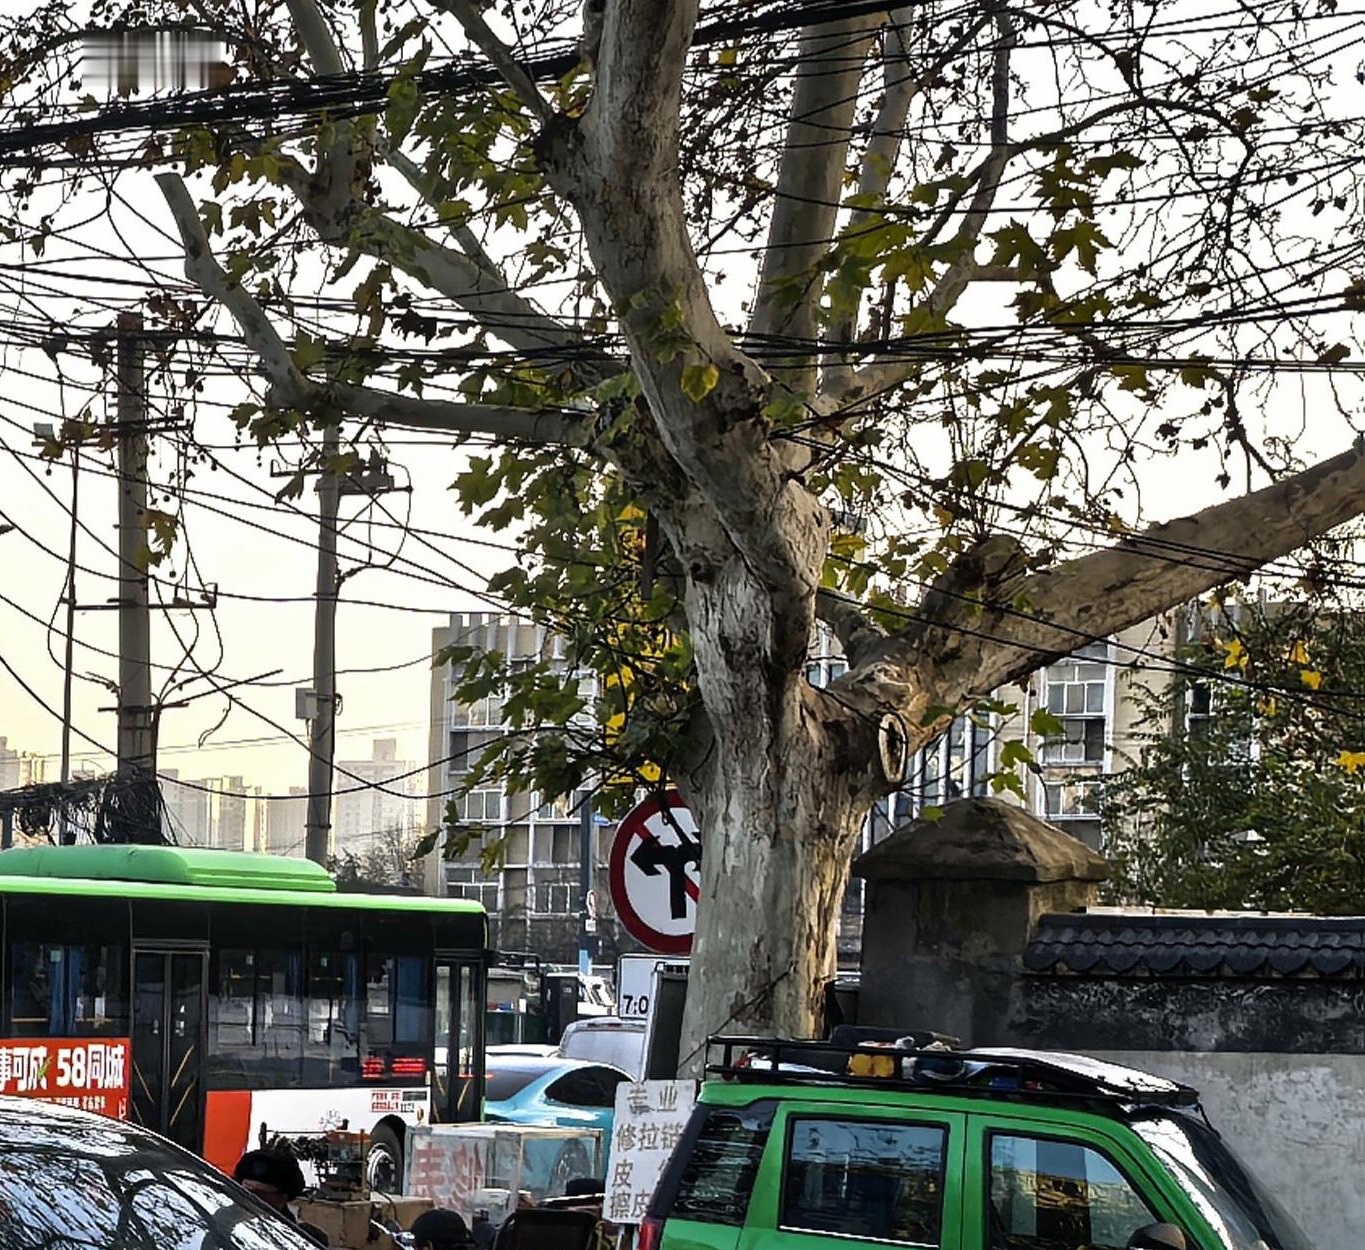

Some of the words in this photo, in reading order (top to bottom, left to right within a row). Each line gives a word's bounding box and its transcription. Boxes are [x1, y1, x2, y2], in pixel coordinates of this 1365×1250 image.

[622, 994, 649, 1015] 7:0
[56, 1043, 124, 1090] 58同城
[609, 1189, 651, 1219] 擦皮
